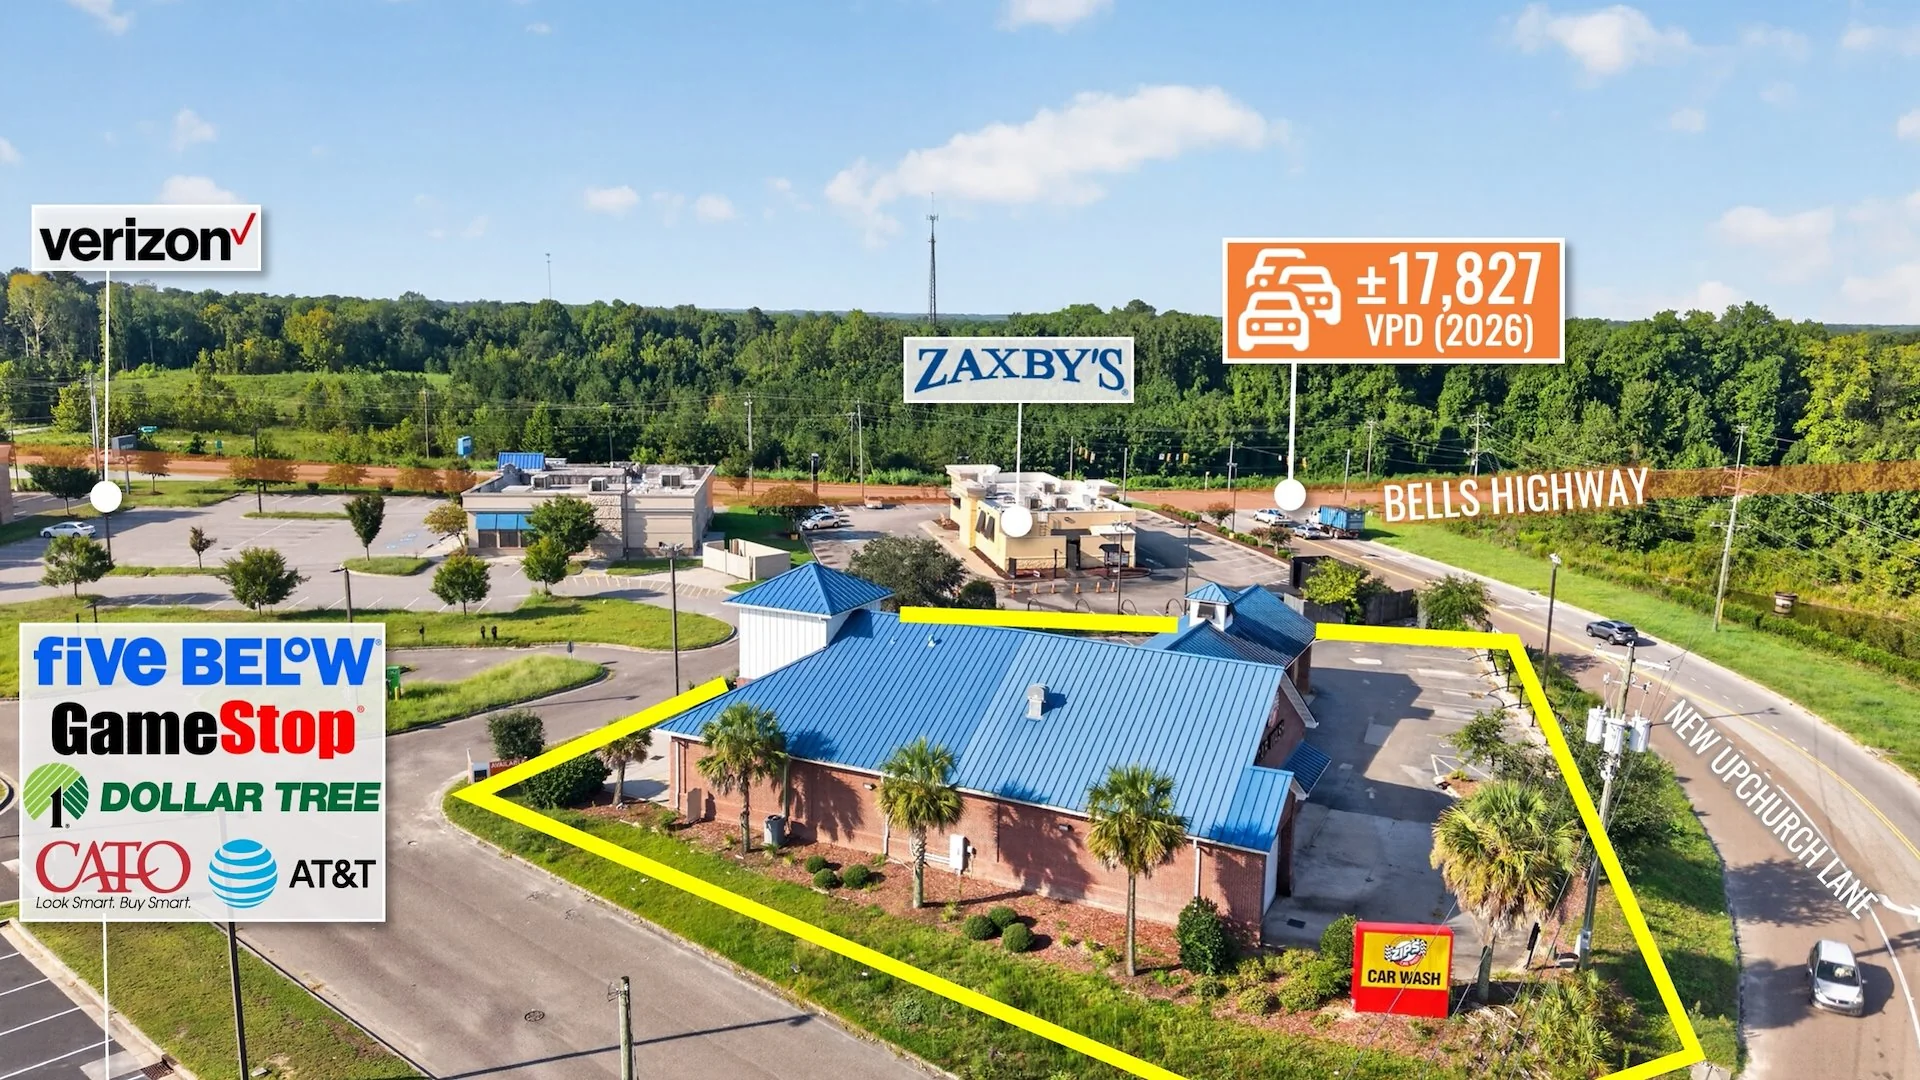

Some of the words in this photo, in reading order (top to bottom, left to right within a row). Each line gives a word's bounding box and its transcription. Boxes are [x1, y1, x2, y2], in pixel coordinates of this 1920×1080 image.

[1391, 940, 1421, 960] ZIPS
[1367, 969, 1396, 984] CAR
[1399, 970, 1441, 986] WASH
